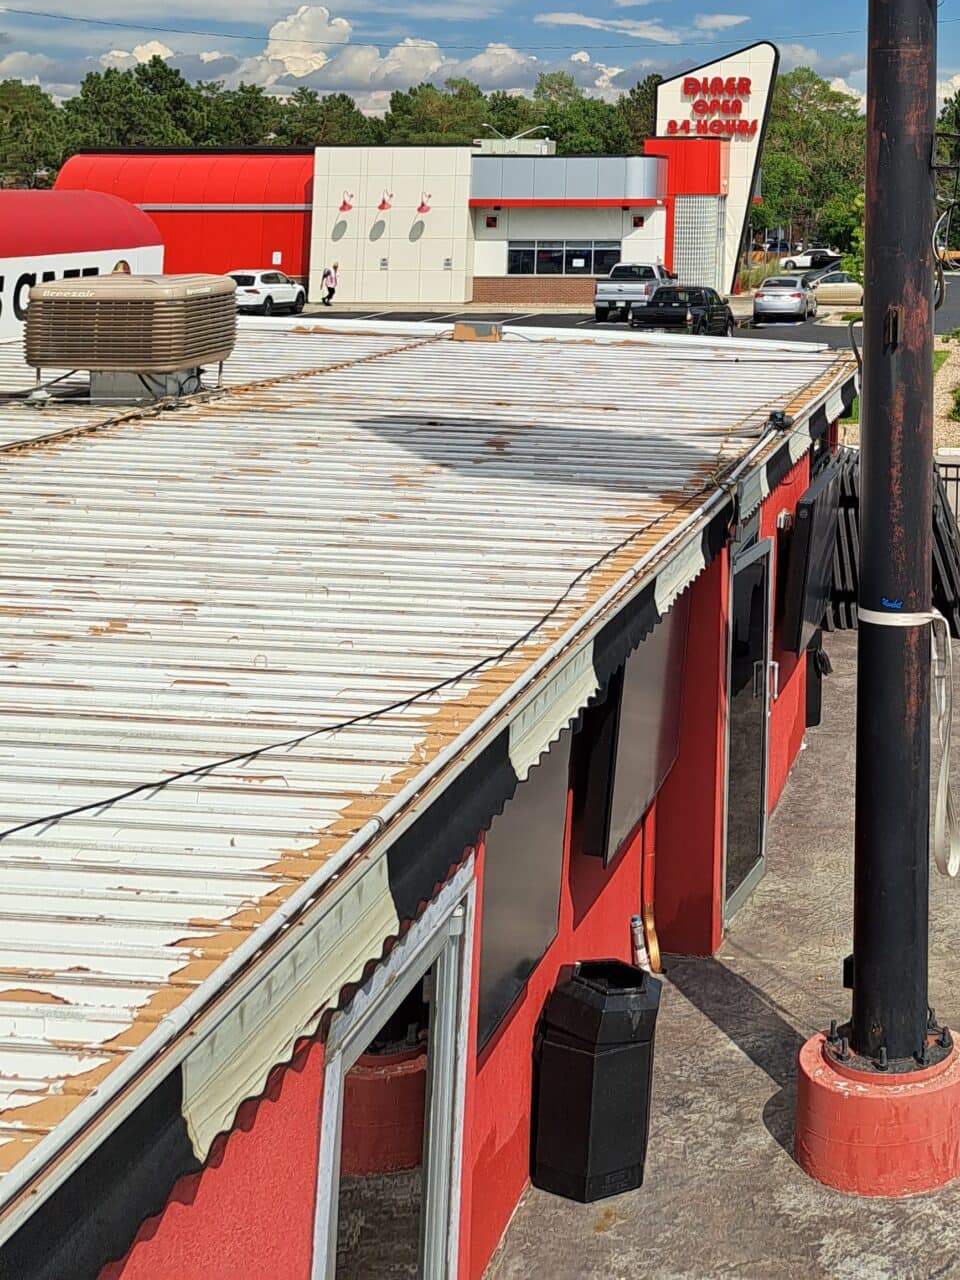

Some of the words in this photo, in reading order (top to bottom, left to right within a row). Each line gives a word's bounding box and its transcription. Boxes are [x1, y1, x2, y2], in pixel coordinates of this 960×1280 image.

[683, 76, 752, 96] DINER
[692, 99, 743, 115] OPEN
[667, 119, 691, 135] 24
[696, 118, 758, 136] HOURS
